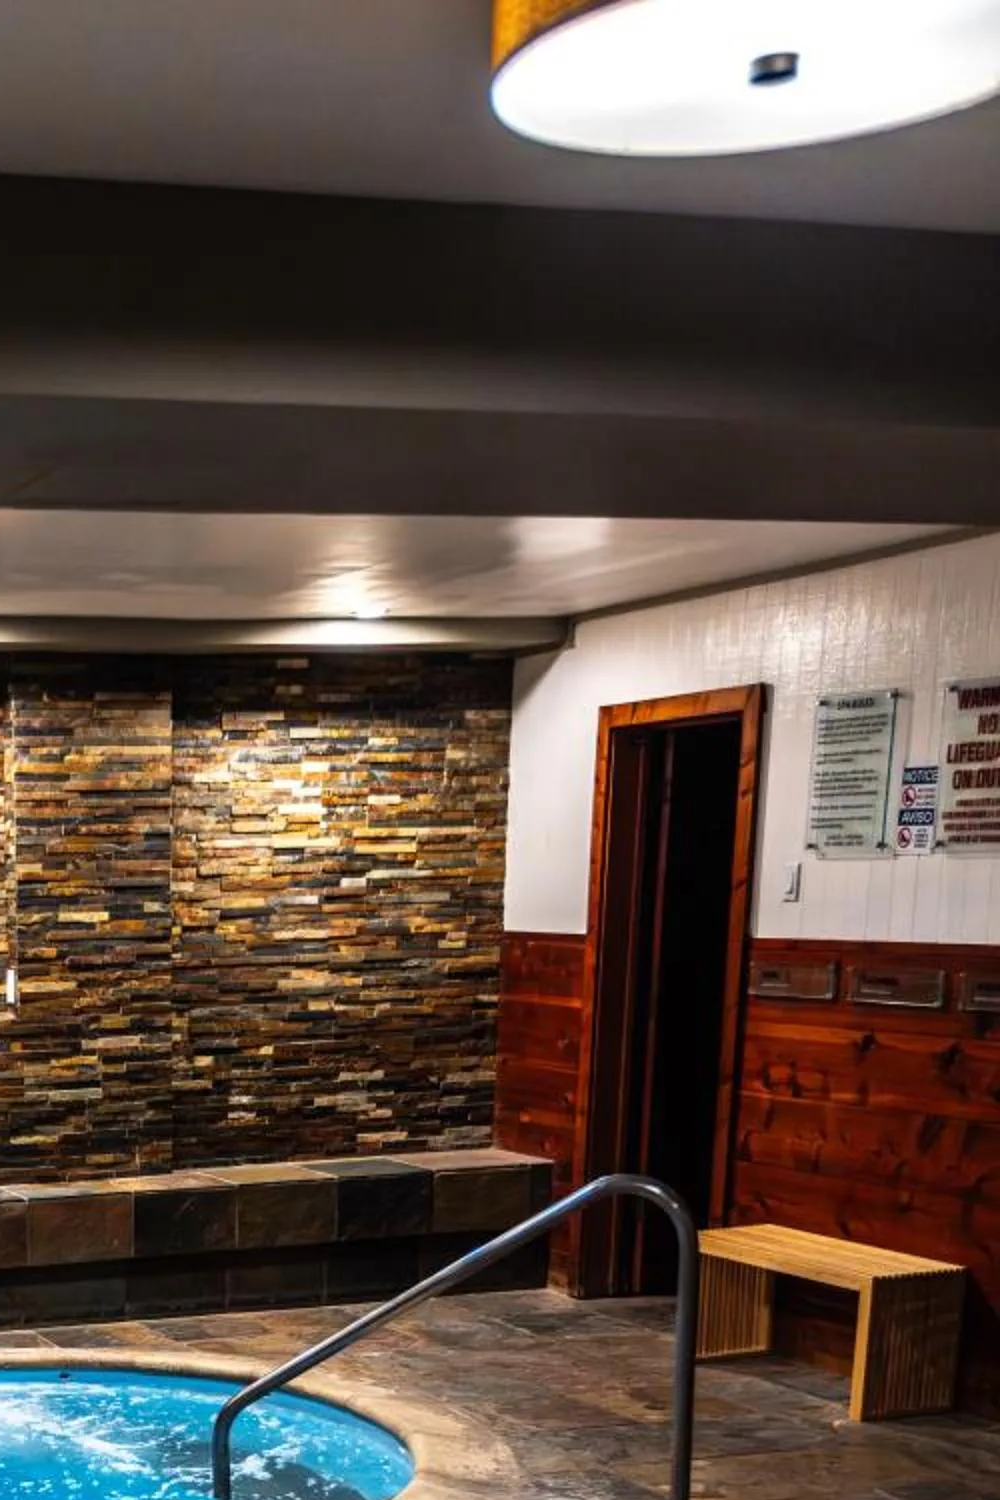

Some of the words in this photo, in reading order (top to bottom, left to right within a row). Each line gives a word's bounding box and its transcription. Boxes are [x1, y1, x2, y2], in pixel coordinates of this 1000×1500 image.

[978, 712, 998, 735] NO
[903, 769, 938, 783] NOTICE
[953, 769, 973, 789] ON
[902, 811, 932, 824] AVISO
